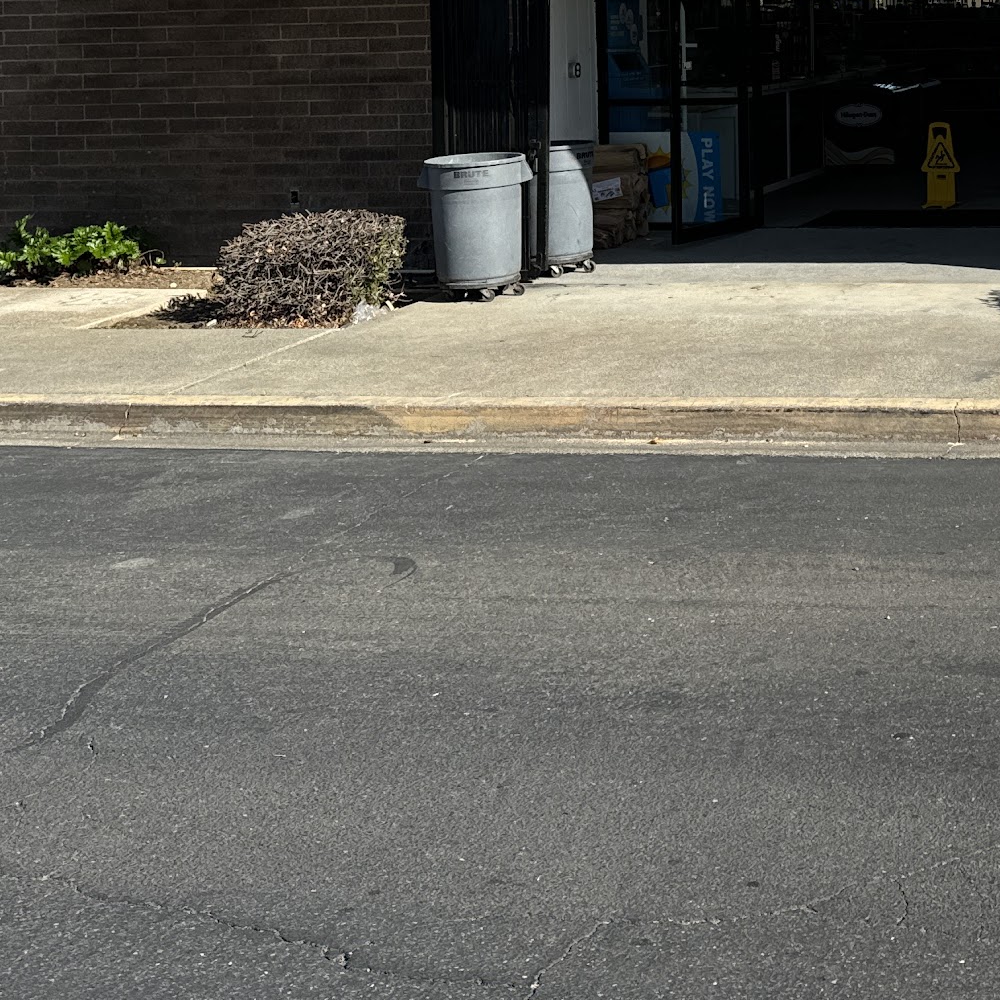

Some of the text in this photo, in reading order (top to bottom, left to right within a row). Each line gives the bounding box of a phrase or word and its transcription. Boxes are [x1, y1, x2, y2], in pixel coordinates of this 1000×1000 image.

[576, 151, 594, 160] BRUT
[453, 169, 489, 179] BRUTE
[701, 137, 716, 223] PLAY NOW
